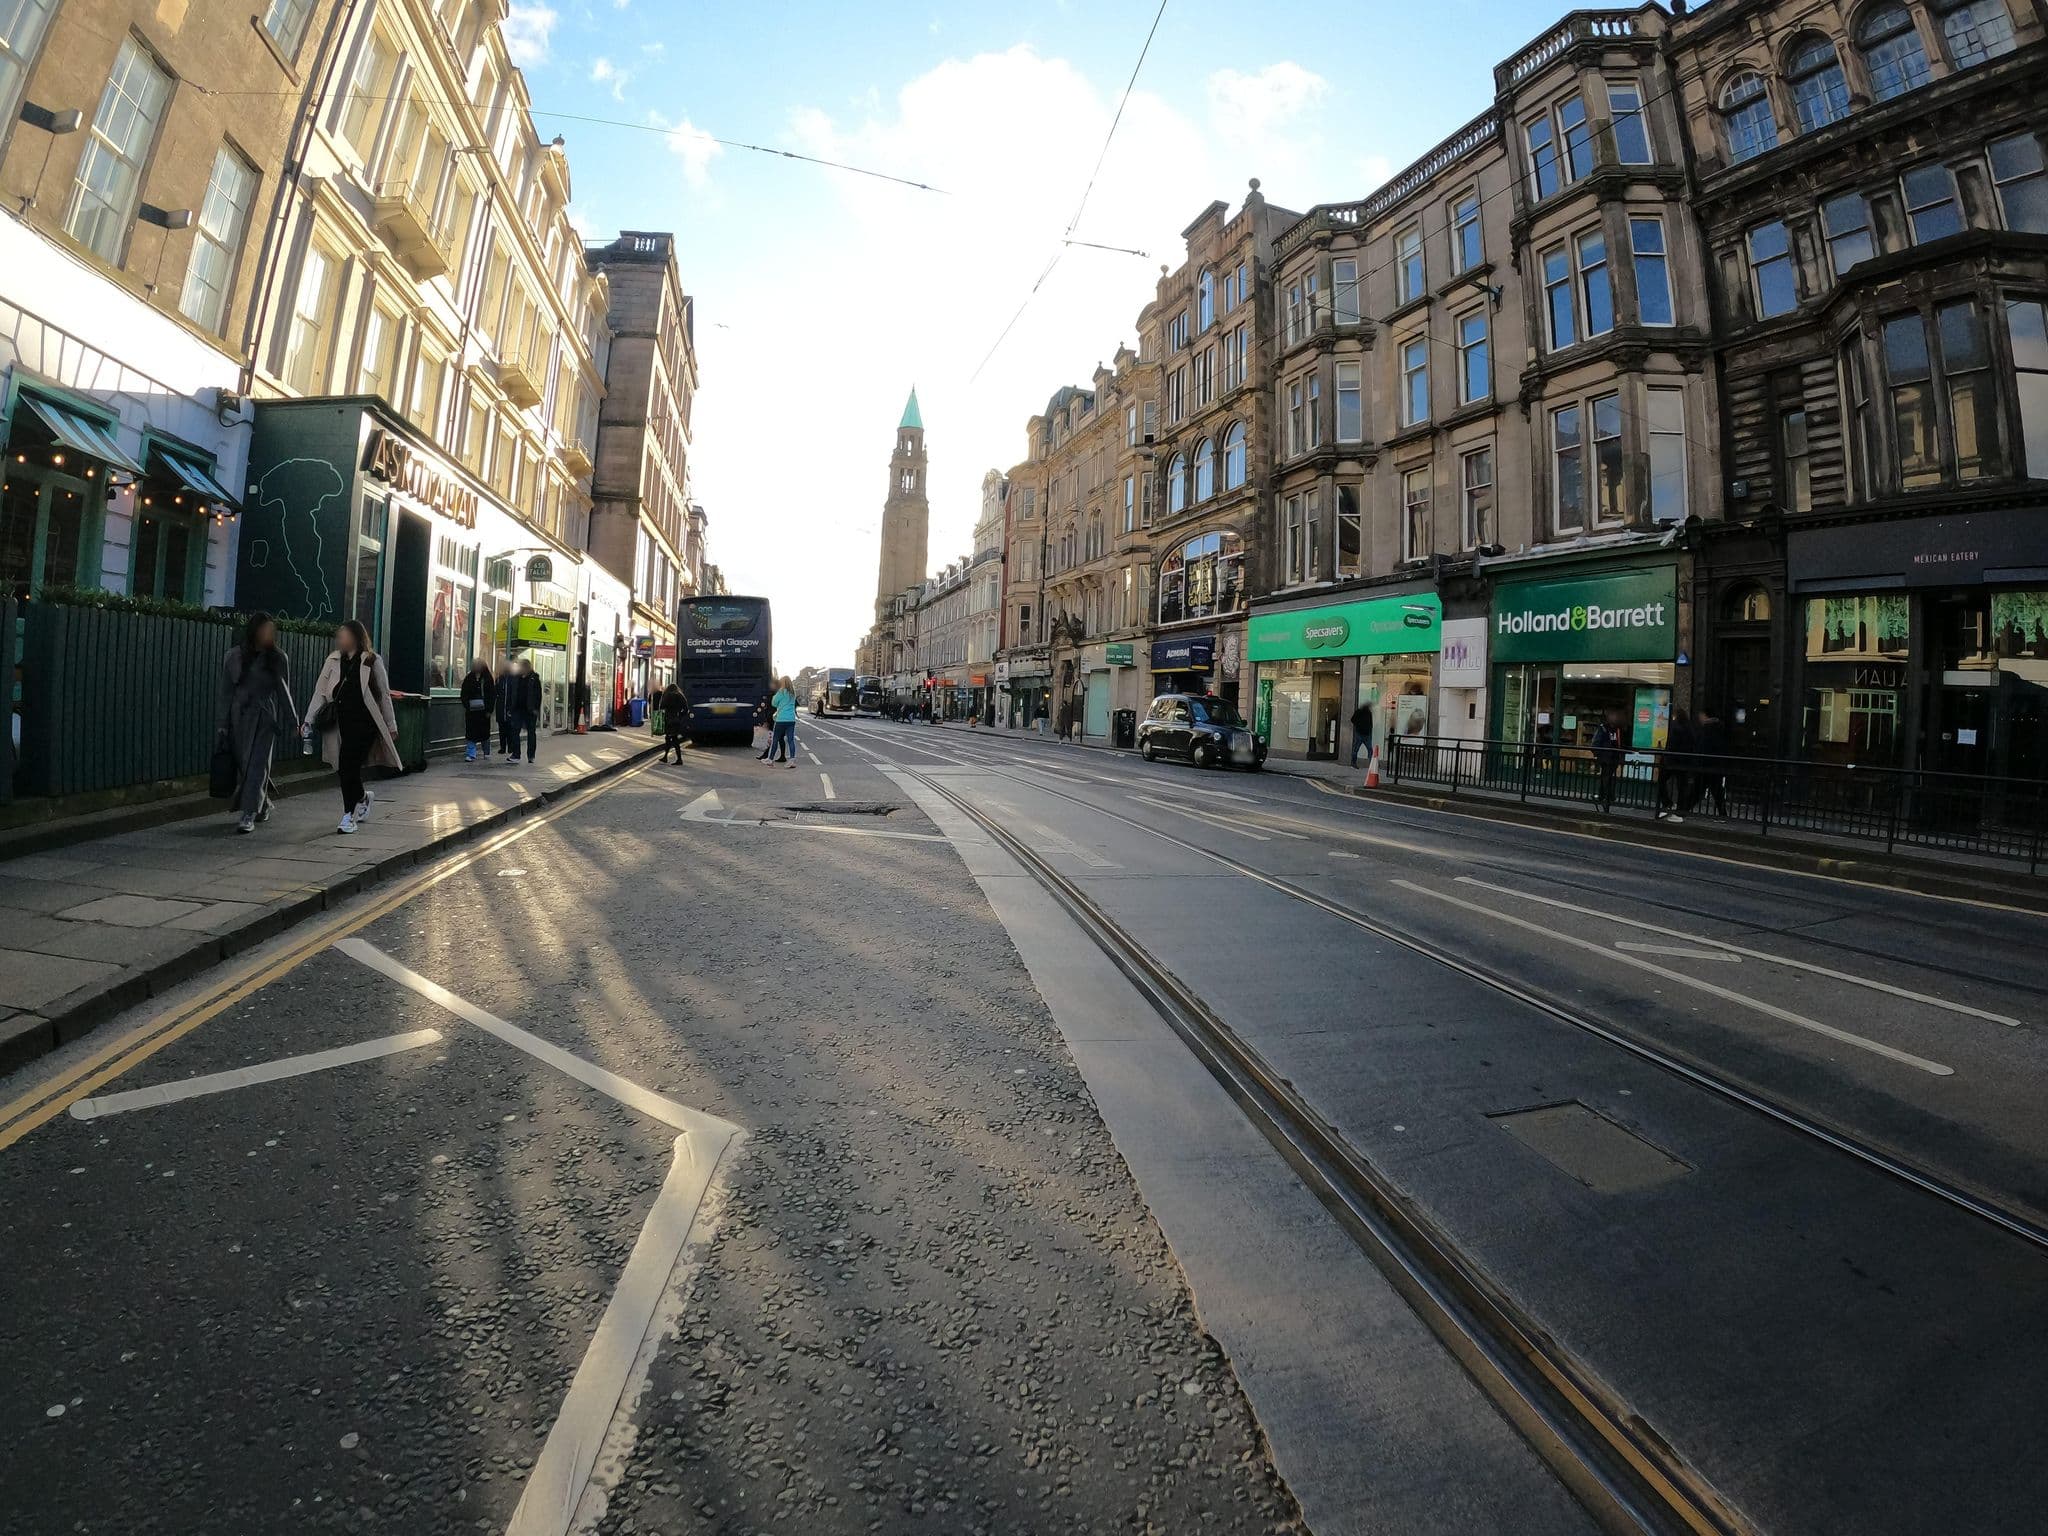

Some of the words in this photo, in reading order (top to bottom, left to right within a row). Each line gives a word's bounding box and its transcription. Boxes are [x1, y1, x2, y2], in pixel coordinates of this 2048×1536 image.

[367, 429, 413, 493] ASK
[1914, 553, 1948, 564] MEXICAN
[1950, 551, 1979, 562] EATERY
[1498, 607, 1570, 634] Holland
[1586, 602, 1665, 630] Barrett
[1305, 626, 1343, 640] Specsavers
[687, 638, 726, 648] Edinburgh
[726, 638, 760, 648] Glasgow
